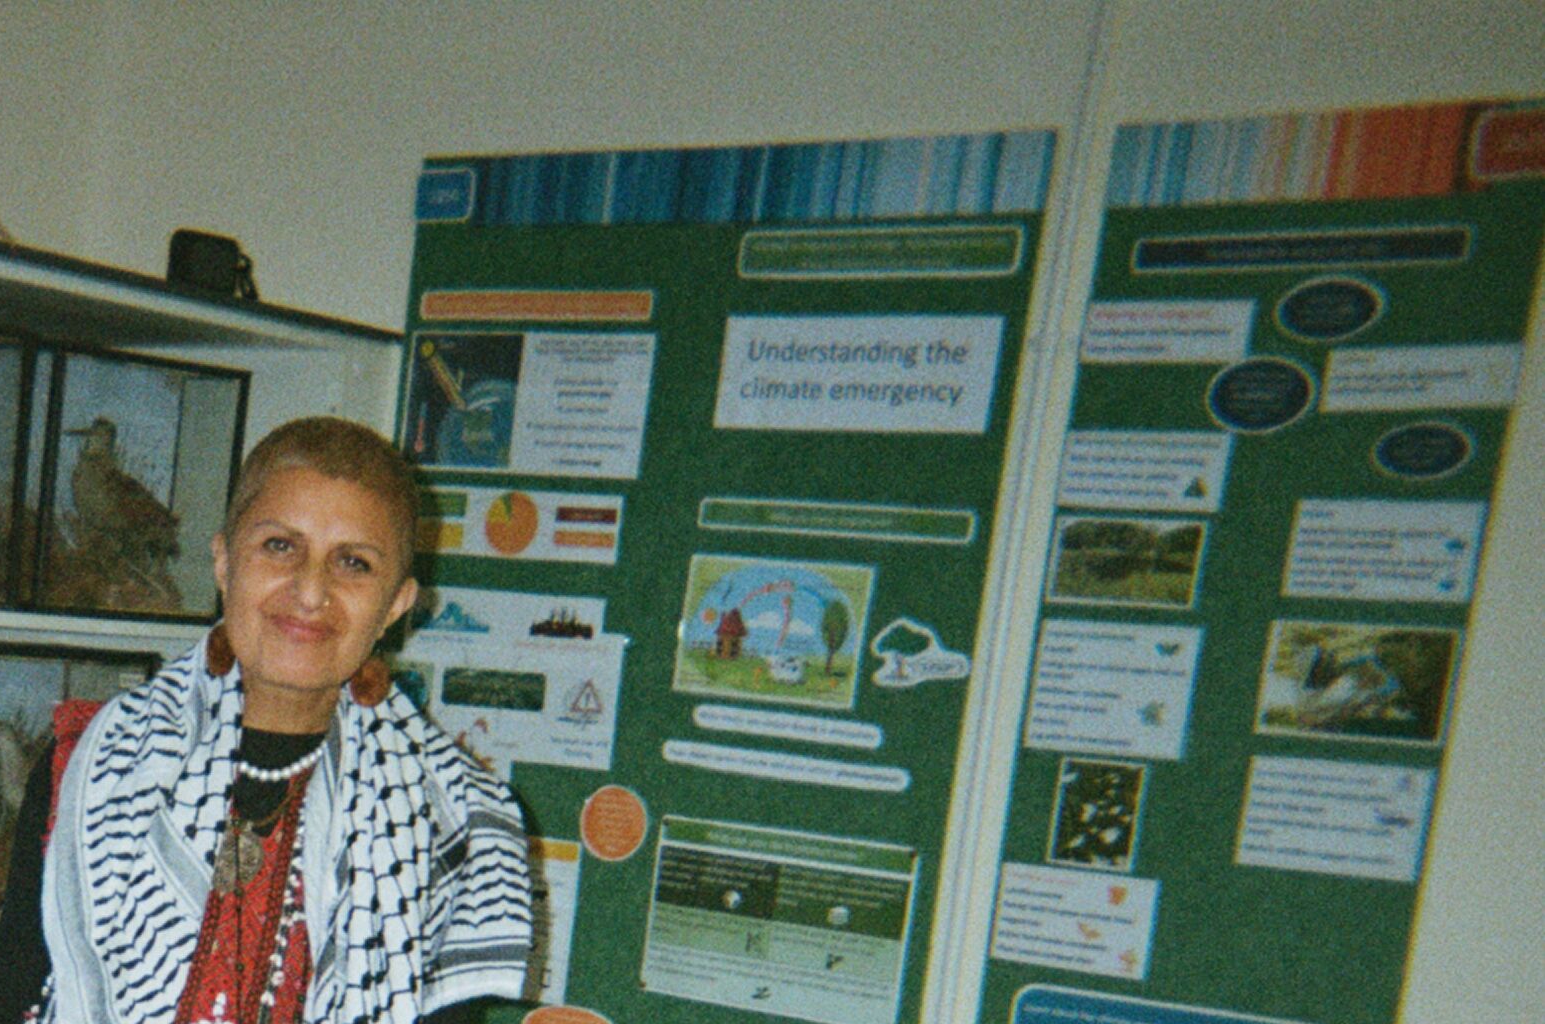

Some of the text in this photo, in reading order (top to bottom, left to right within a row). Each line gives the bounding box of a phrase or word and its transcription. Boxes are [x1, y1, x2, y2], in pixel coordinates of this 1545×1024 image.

[747, 338, 968, 368] Understanding the
[739, 376, 964, 406] climate emergency
